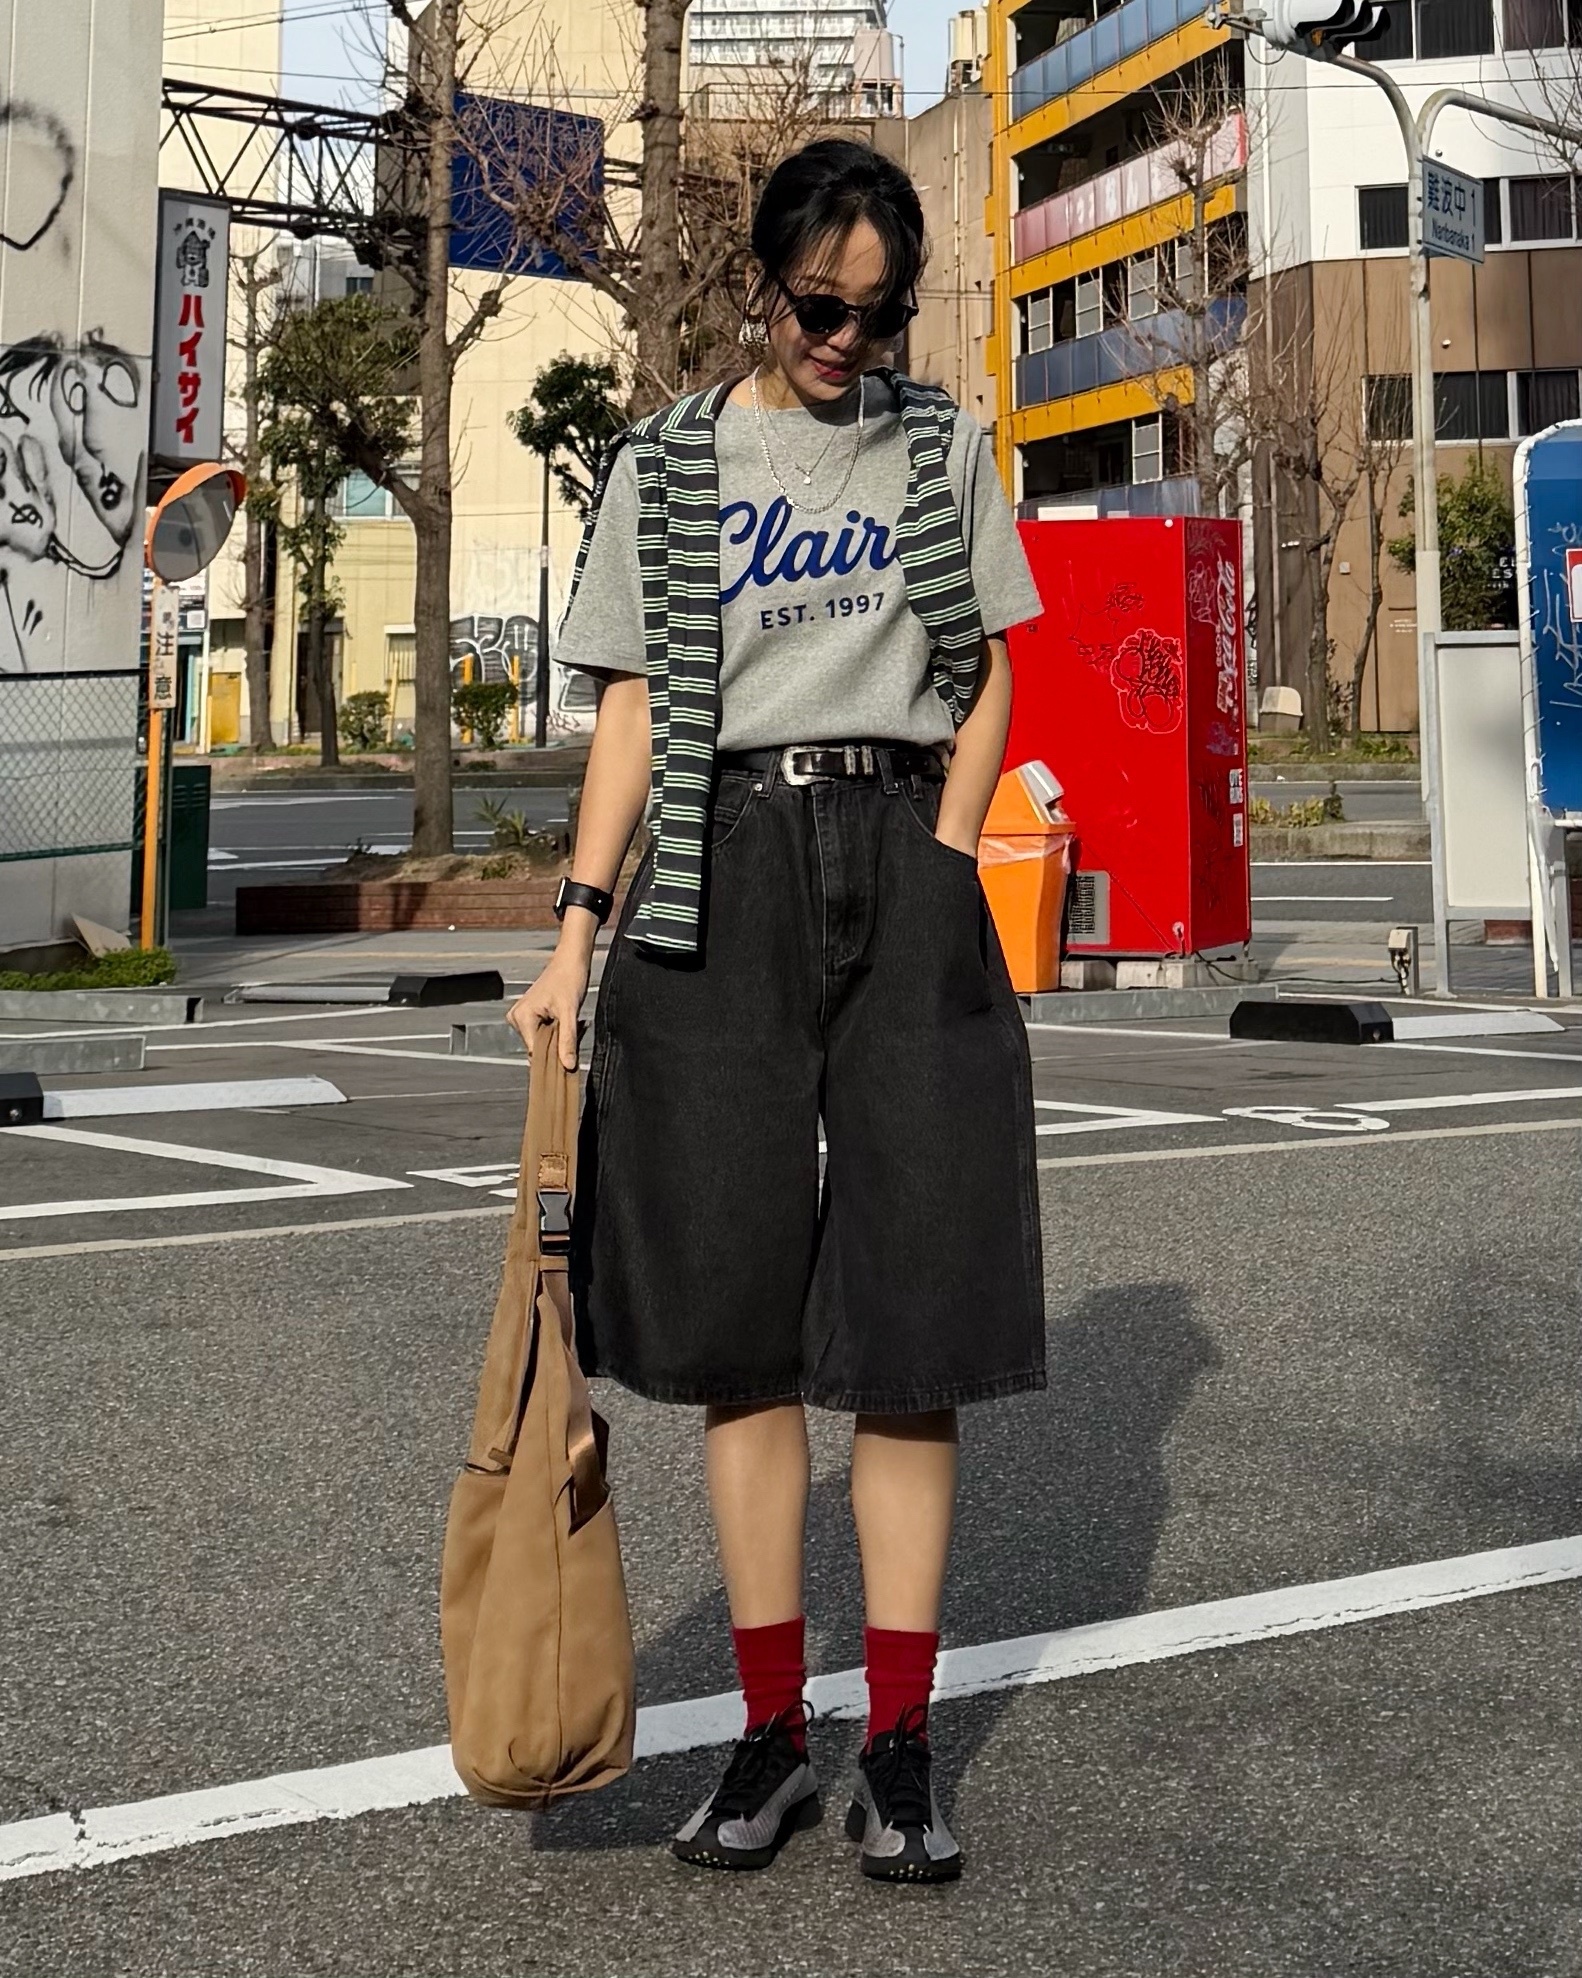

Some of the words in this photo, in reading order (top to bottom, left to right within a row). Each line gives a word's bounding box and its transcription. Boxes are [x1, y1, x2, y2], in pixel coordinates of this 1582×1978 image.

[176, 294, 205, 443] ハイサイ
[719, 495, 899, 606] Clair
[761, 604, 815, 630] EST.
[826, 592, 885, 619] 1997
